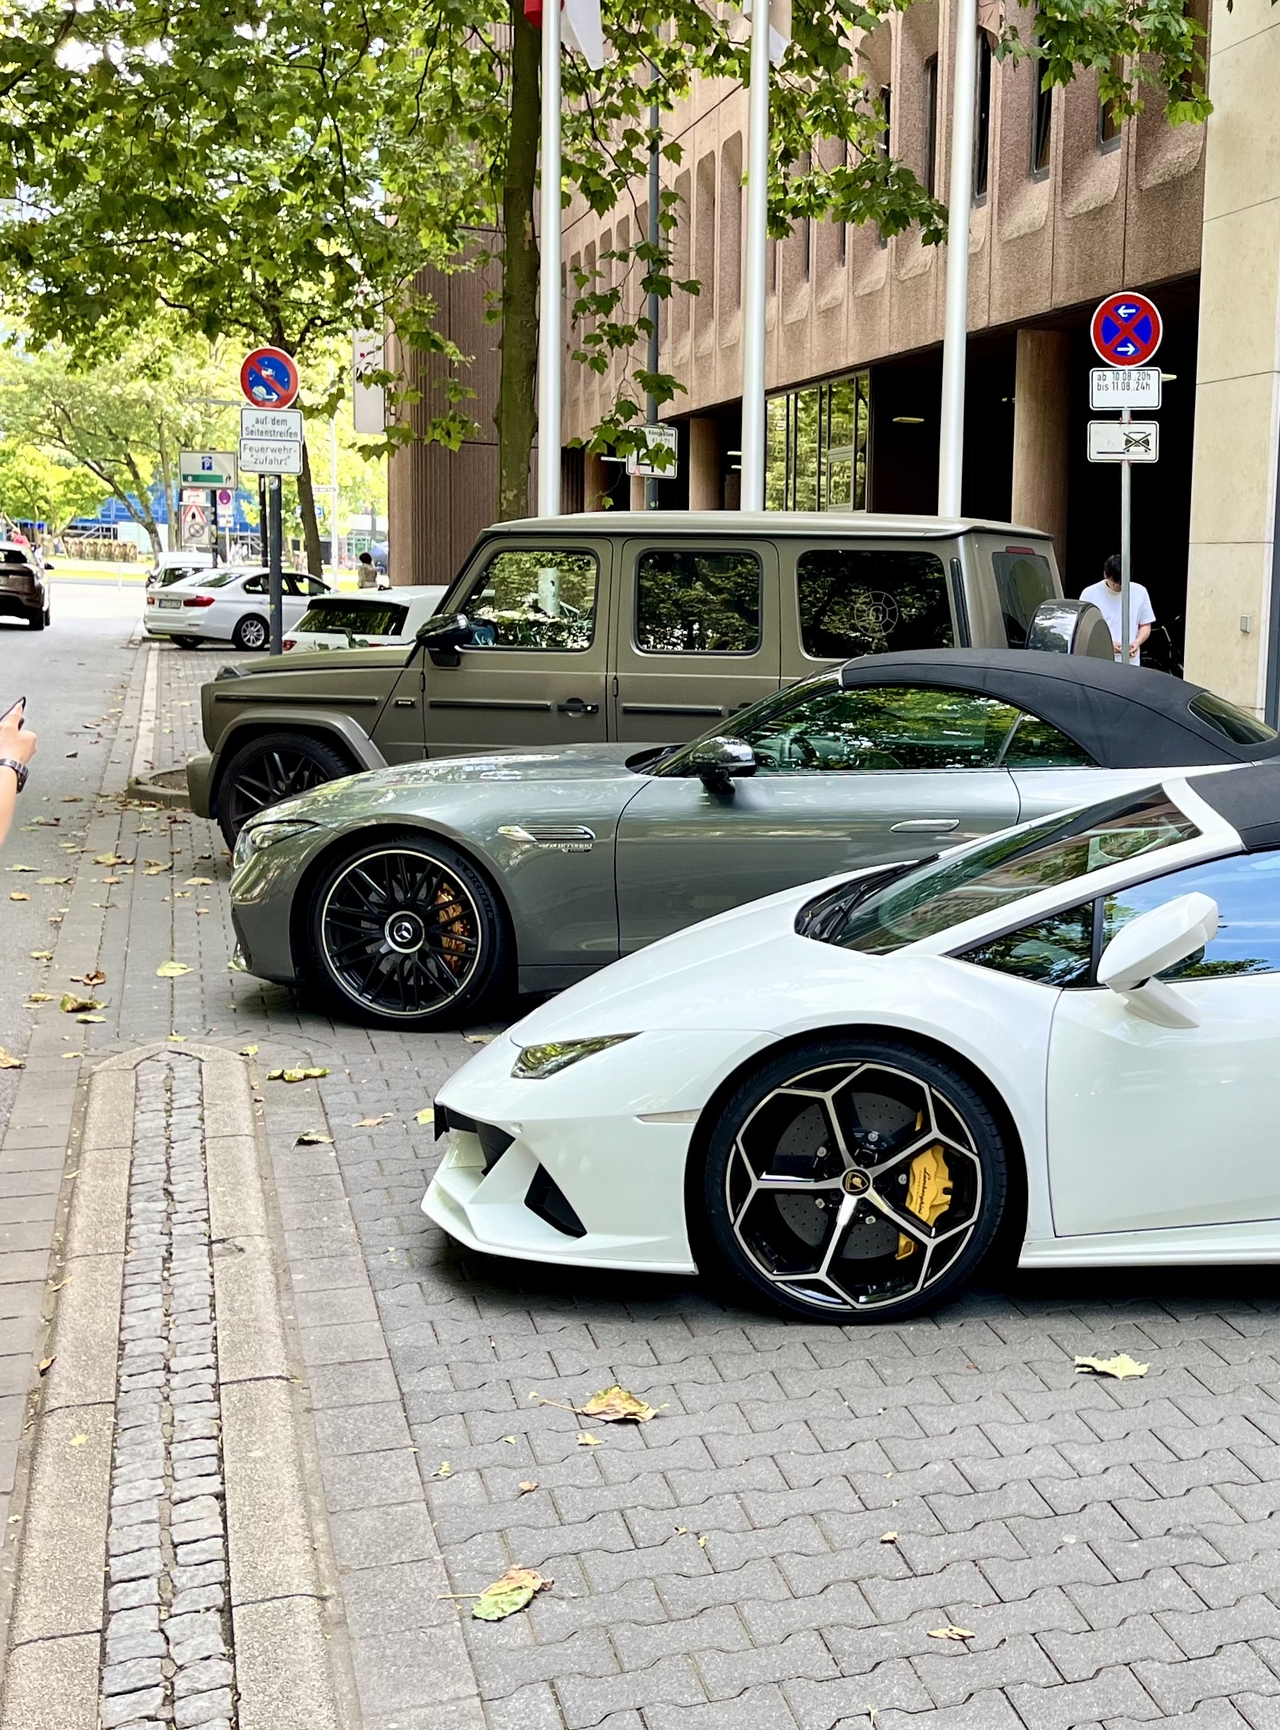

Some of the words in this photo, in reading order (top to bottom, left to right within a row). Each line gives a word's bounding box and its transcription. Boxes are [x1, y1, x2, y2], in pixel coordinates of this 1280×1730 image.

[1097, 372, 1107, 381] ab
[1137, 371, 1151, 381] 20h
[1097, 382, 1109, 391] bis
[1136, 381, 1150, 391] 24h
[255, 416, 268, 425] auf
[271, 416, 288, 426] dem
[245, 427, 298, 438] Seitenstreifen
[243, 444, 297, 454] Feuerwehr-
